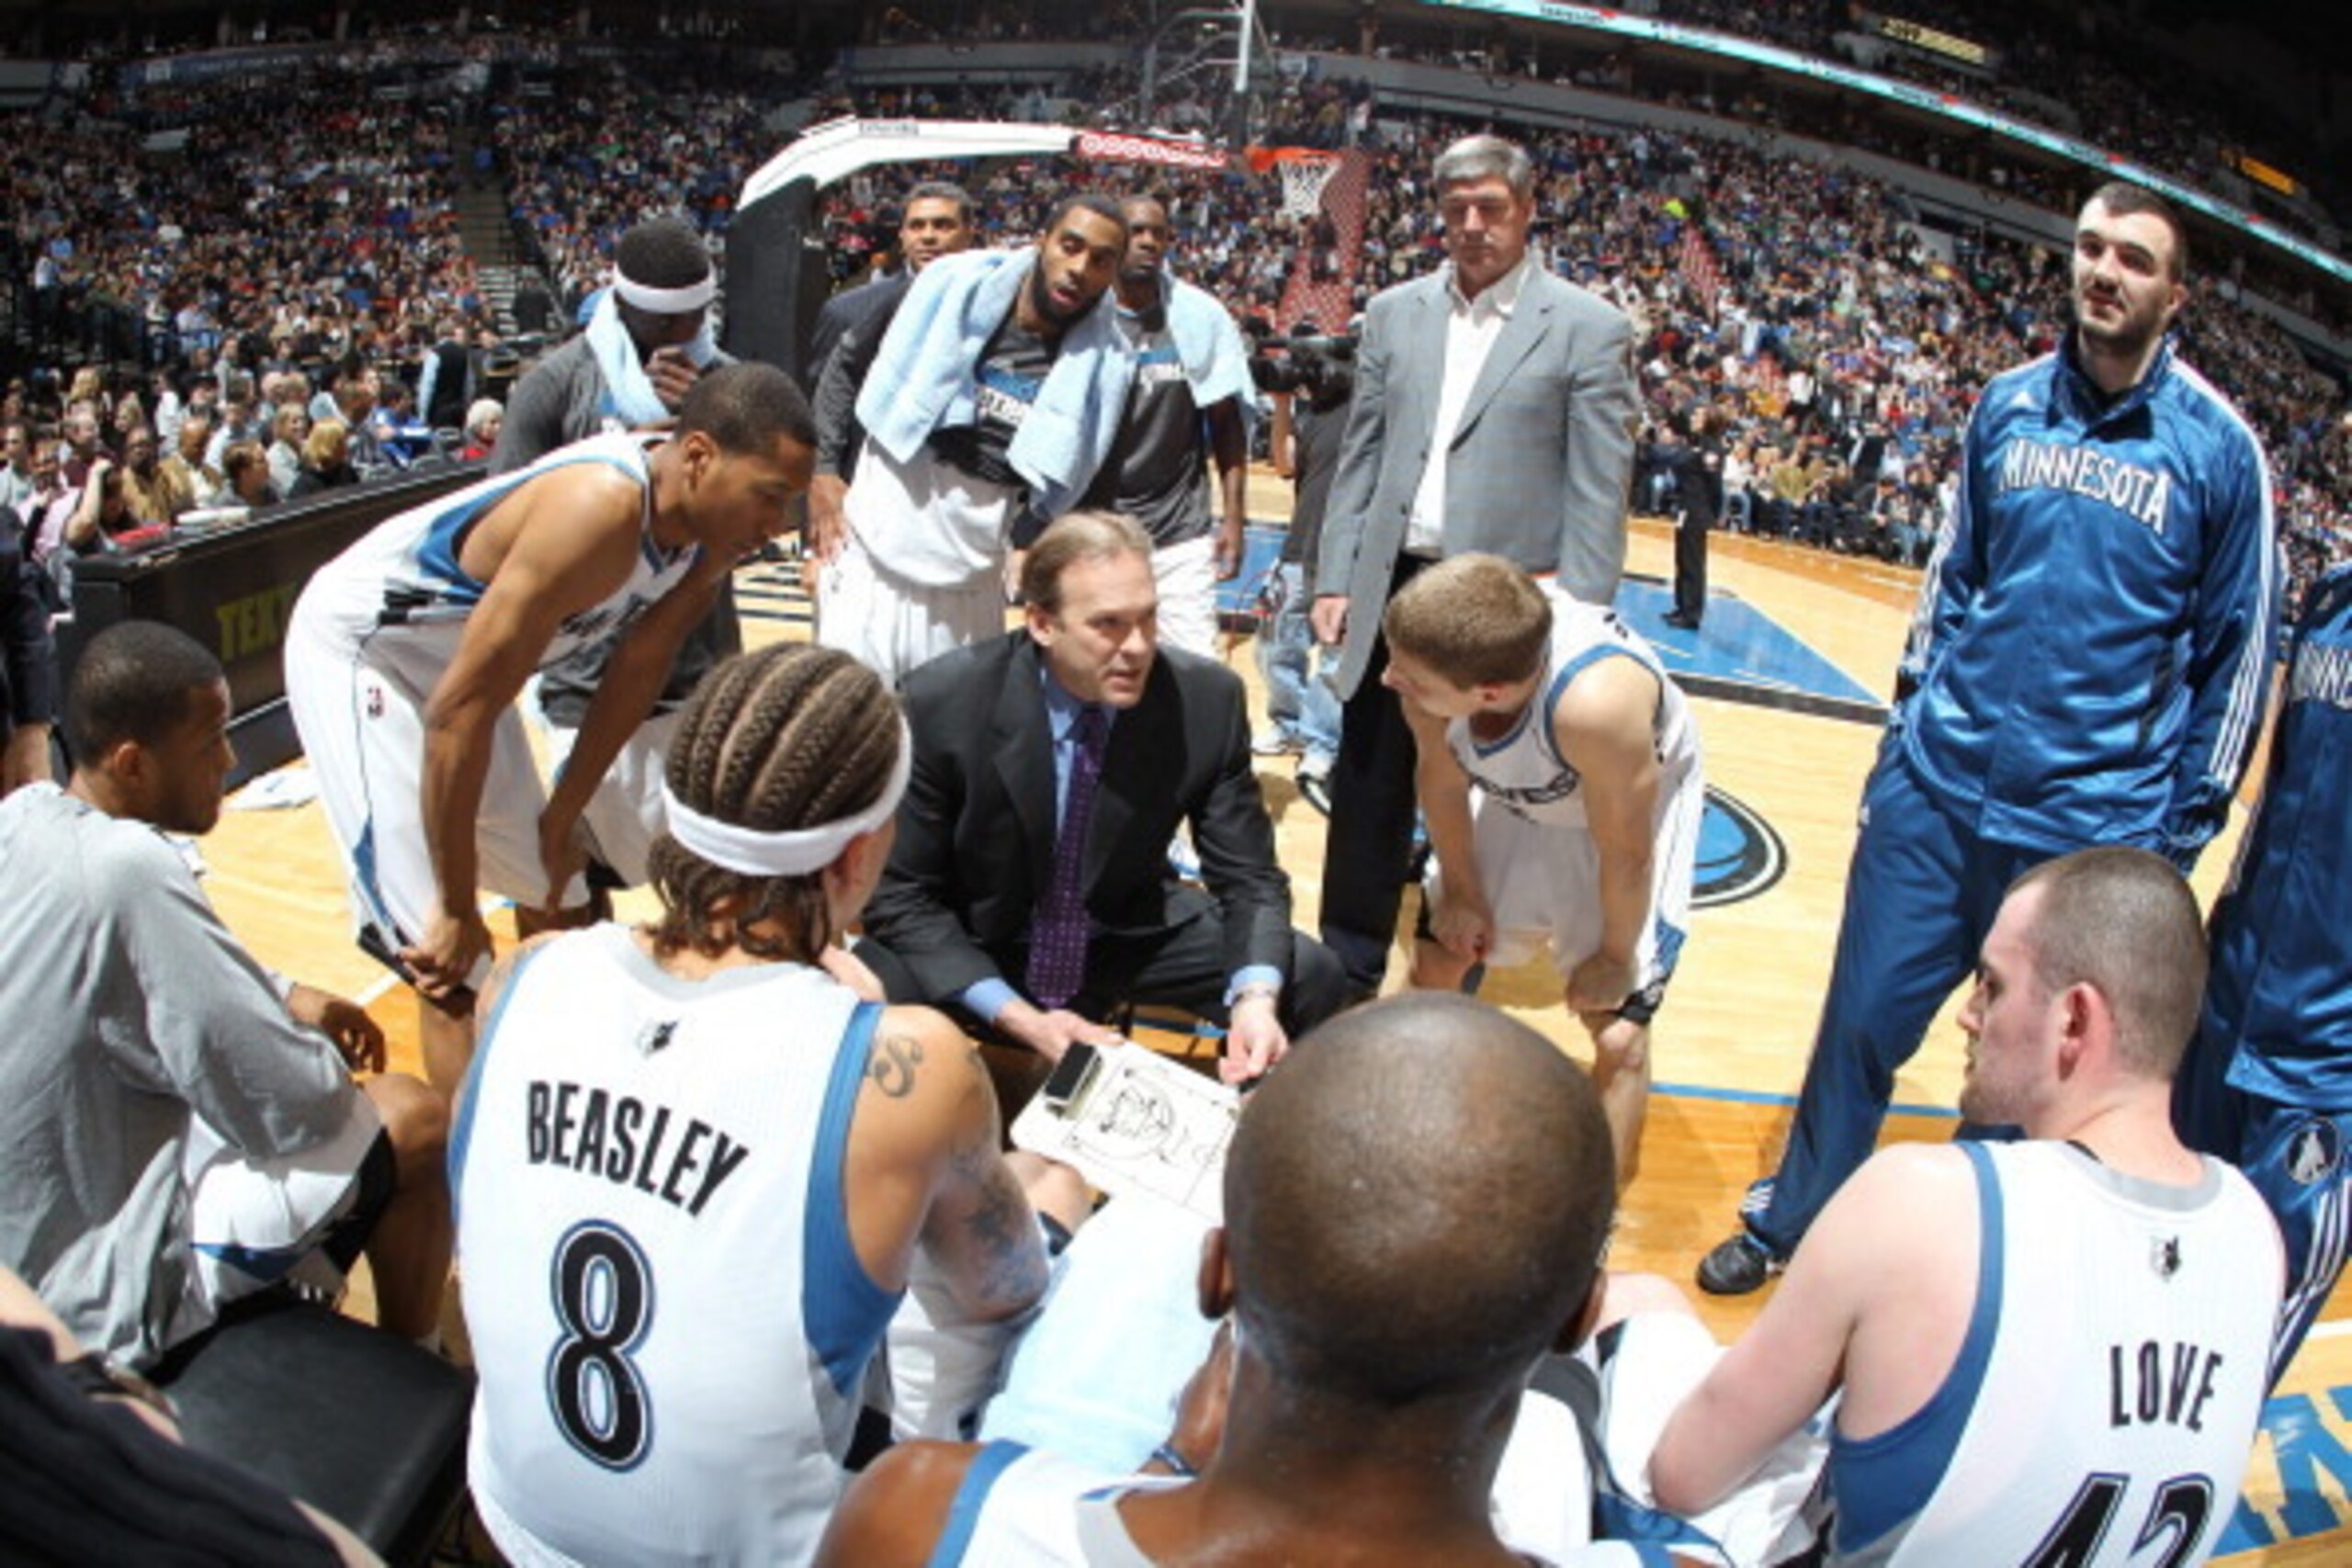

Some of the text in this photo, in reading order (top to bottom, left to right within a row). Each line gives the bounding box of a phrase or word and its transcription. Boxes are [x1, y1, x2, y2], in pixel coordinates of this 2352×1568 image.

[1999, 437, 2172, 536] MINNESOTA
[527, 1080, 749, 1217] BEASLEY
[546, 1219, 656, 1473] 8
[2109, 1338, 2222, 1433] LOVE
